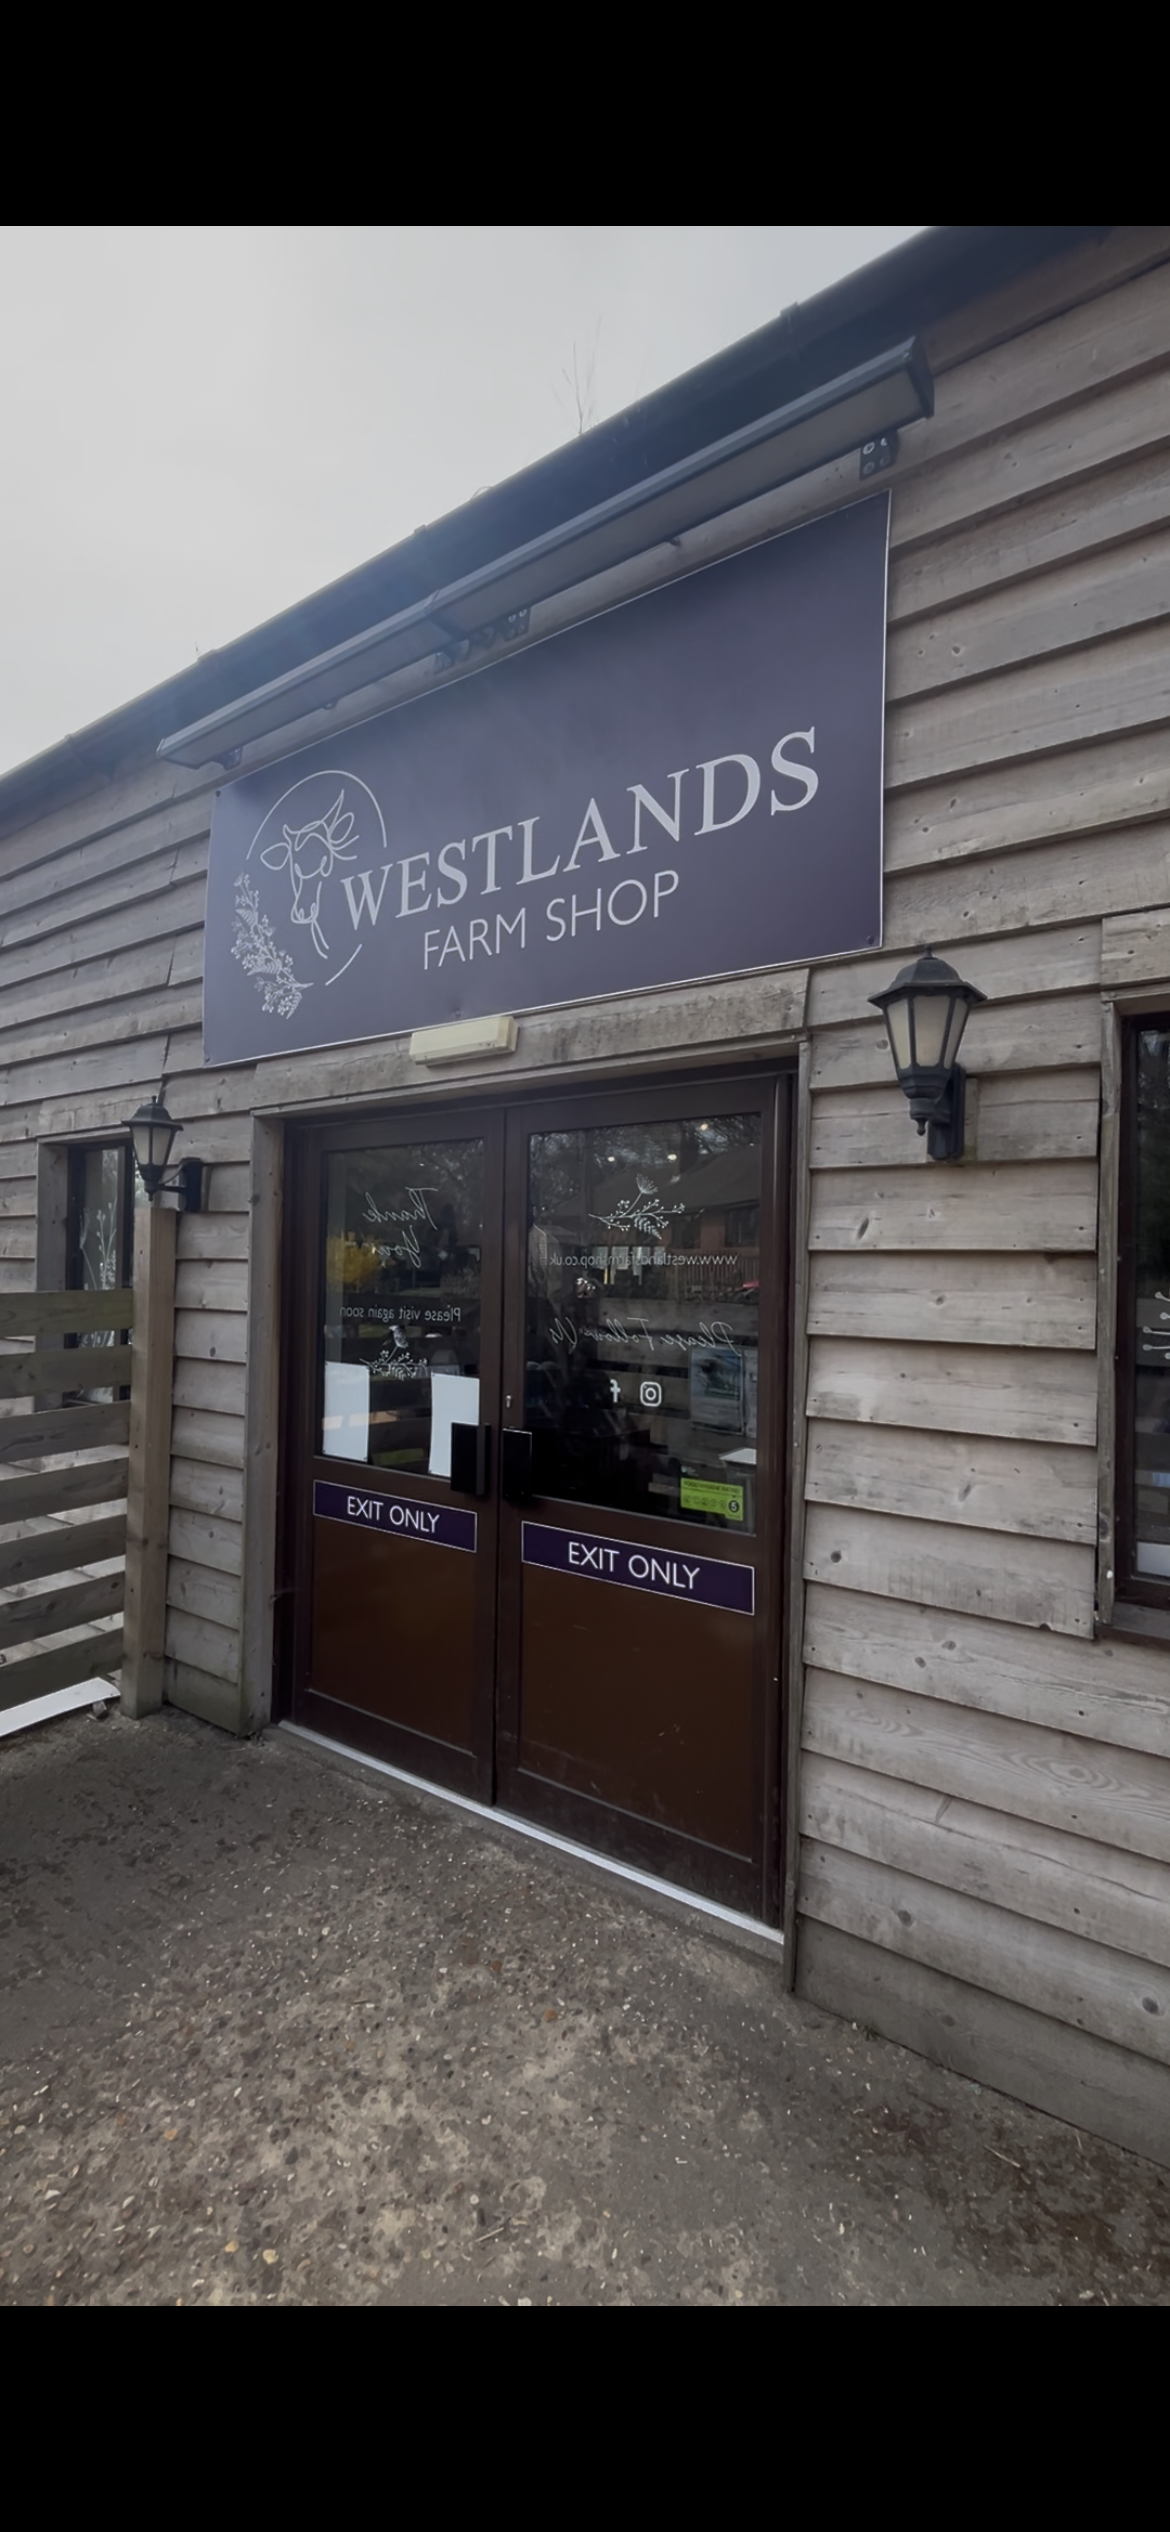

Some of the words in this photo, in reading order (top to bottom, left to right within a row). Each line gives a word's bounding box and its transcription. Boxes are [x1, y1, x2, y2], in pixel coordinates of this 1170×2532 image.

[340, 726, 819, 931] WESTLANDS
[423, 907, 527, 970] FARM
[546, 869, 680, 941] SHOP
[347, 1495, 384, 1521] EXIT
[389, 1505, 441, 1534] ONLY
[568, 1541, 620, 1572] EXIT
[628, 1554, 701, 1590] ONLY
